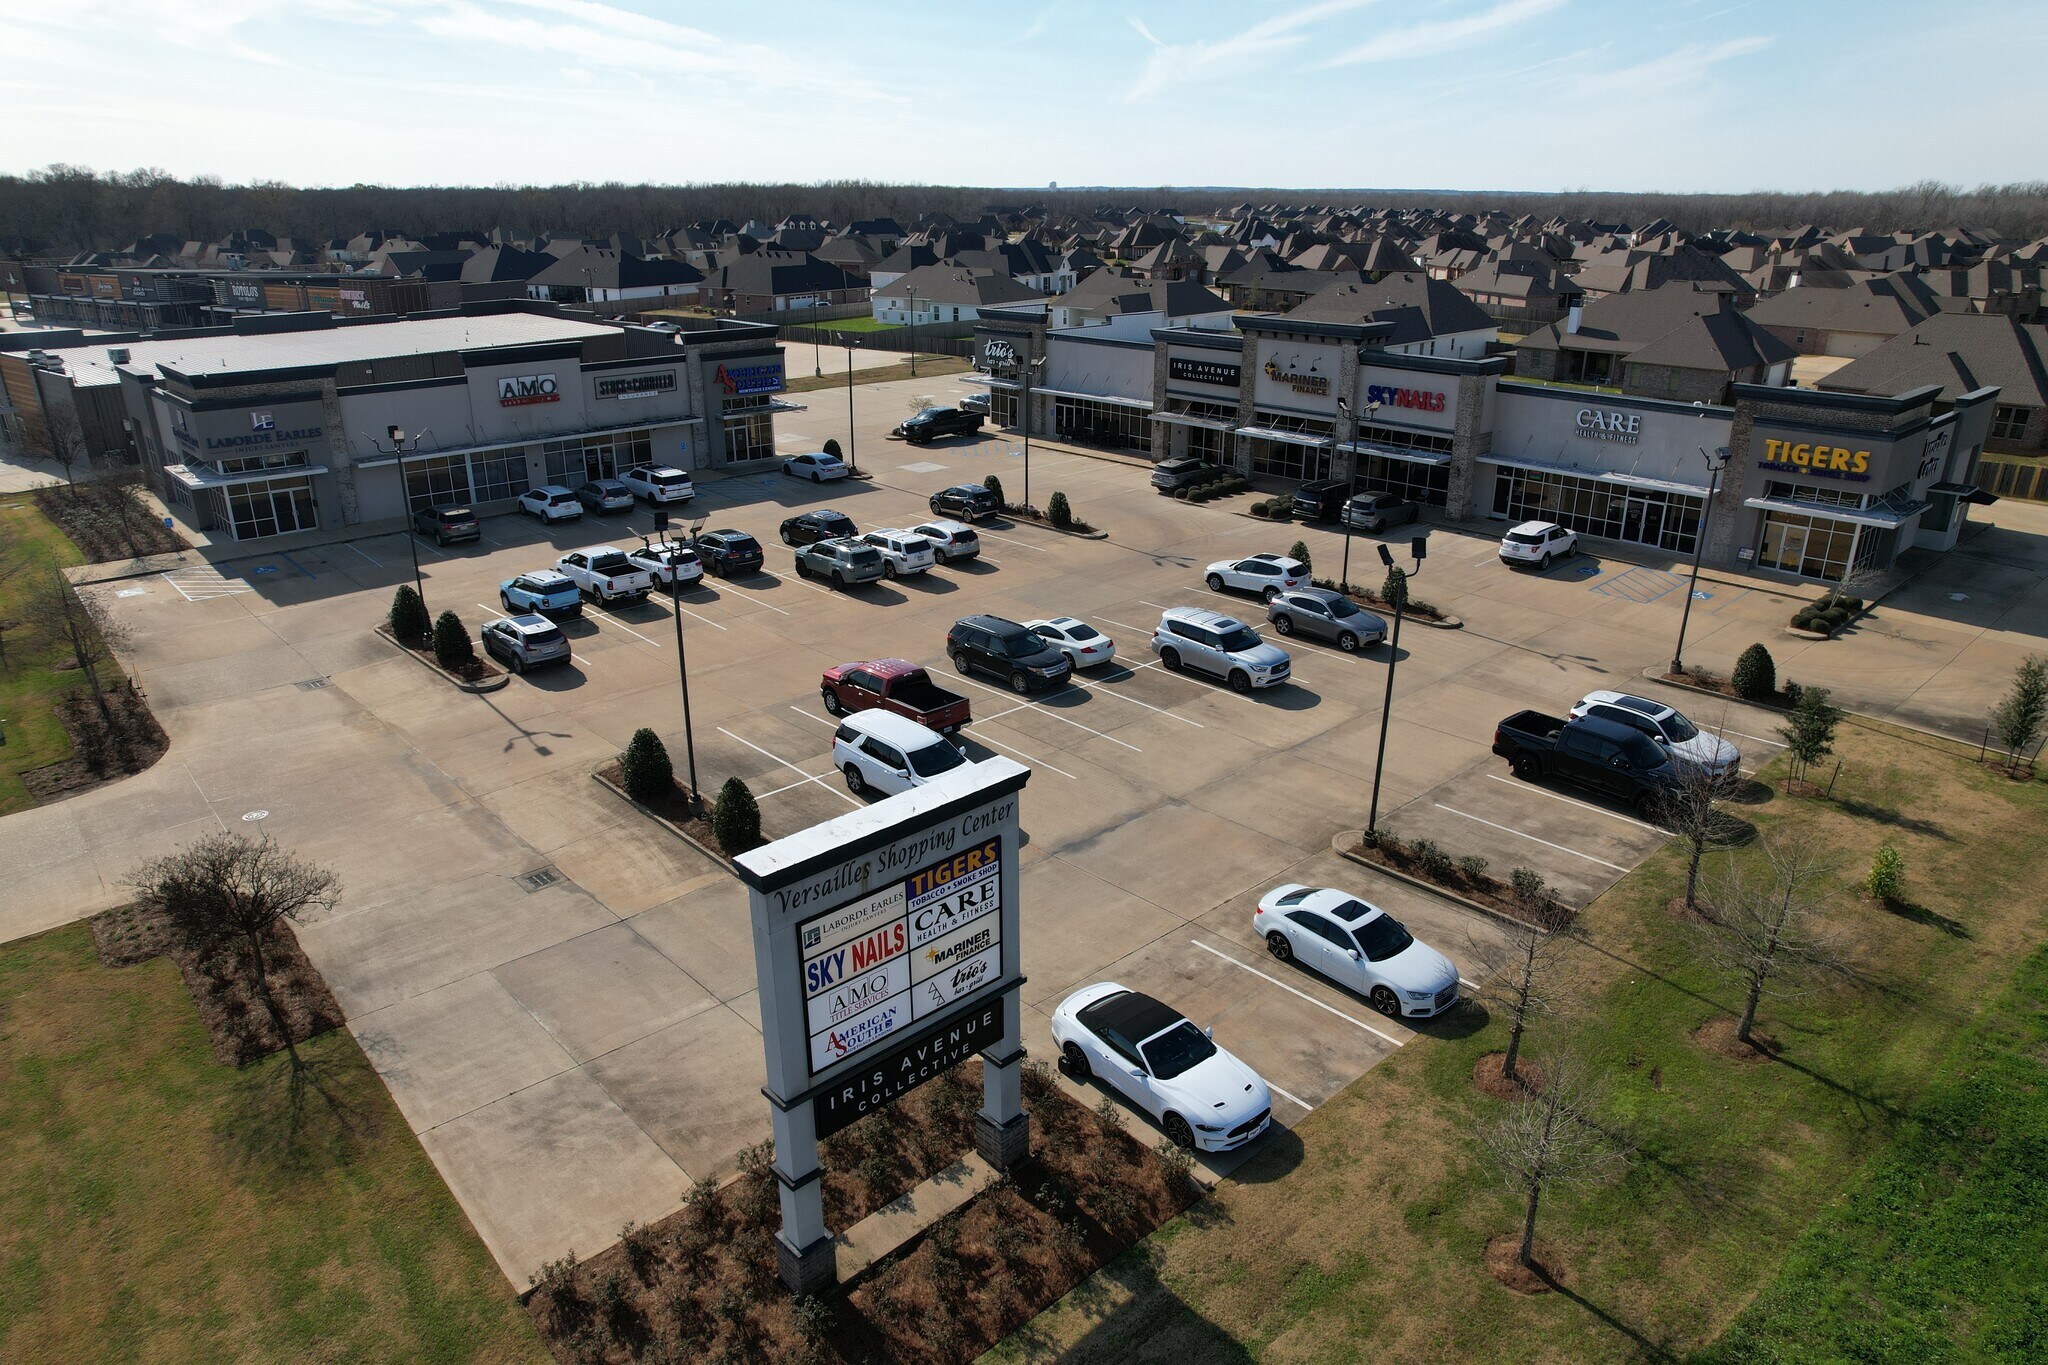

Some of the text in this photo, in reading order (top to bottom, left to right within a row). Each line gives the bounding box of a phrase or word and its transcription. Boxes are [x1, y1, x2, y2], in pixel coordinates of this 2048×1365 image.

[983, 338, 1014, 358] trio's
[713, 363, 782, 384] AMERICAN
[1173, 362, 1236, 376] IRIS AVENUE
[1183, 372, 1224, 382] COLLECTIVE
[1271, 370, 1328, 388] MARINER
[502, 378, 557, 399] AMO
[1292, 384, 1328, 396] FINANCE
[1575, 429, 1599, 439] HEALTH
[1609, 434, 1637, 444] FITNESS
[1576, 409, 1641, 434] CARE
[206, 432, 272, 449] LABORDE
[276, 428, 322, 441] EARLES
[235, 441, 300, 453] INJURY LAWYERS
[1765, 438, 1871, 474] TIGERS
[774, 800, 1014, 914] Versailles Shopping Center
[911, 842, 996, 896] TIGERS
[911, 863, 997, 908] TOBACCO SMOKE SHOP
[822, 891, 904, 934] LABORDE EARLES
[841, 909, 887, 932] INJURY LAWYERS
[914, 880, 996, 931] CARE
[917, 900, 994, 942] HEALTH & FITNESS
[807, 923, 905, 993] SKY NAILS
[934, 928, 990, 965] MARINER
[955, 937, 991, 961] FINANCE
[950, 959, 988, 988] trio's
[830, 988, 889, 1023] TITLE SERVICES
[831, 974, 887, 1014] AMO
[954, 987, 965, 995] bar
[824, 1006, 897, 1054] AMERICAN
[835, 1023, 883, 1058] SOUTH
[830, 1011, 992, 1110] IRIS AVENUE
[858, 1043, 970, 1112] COLLECTIVE
